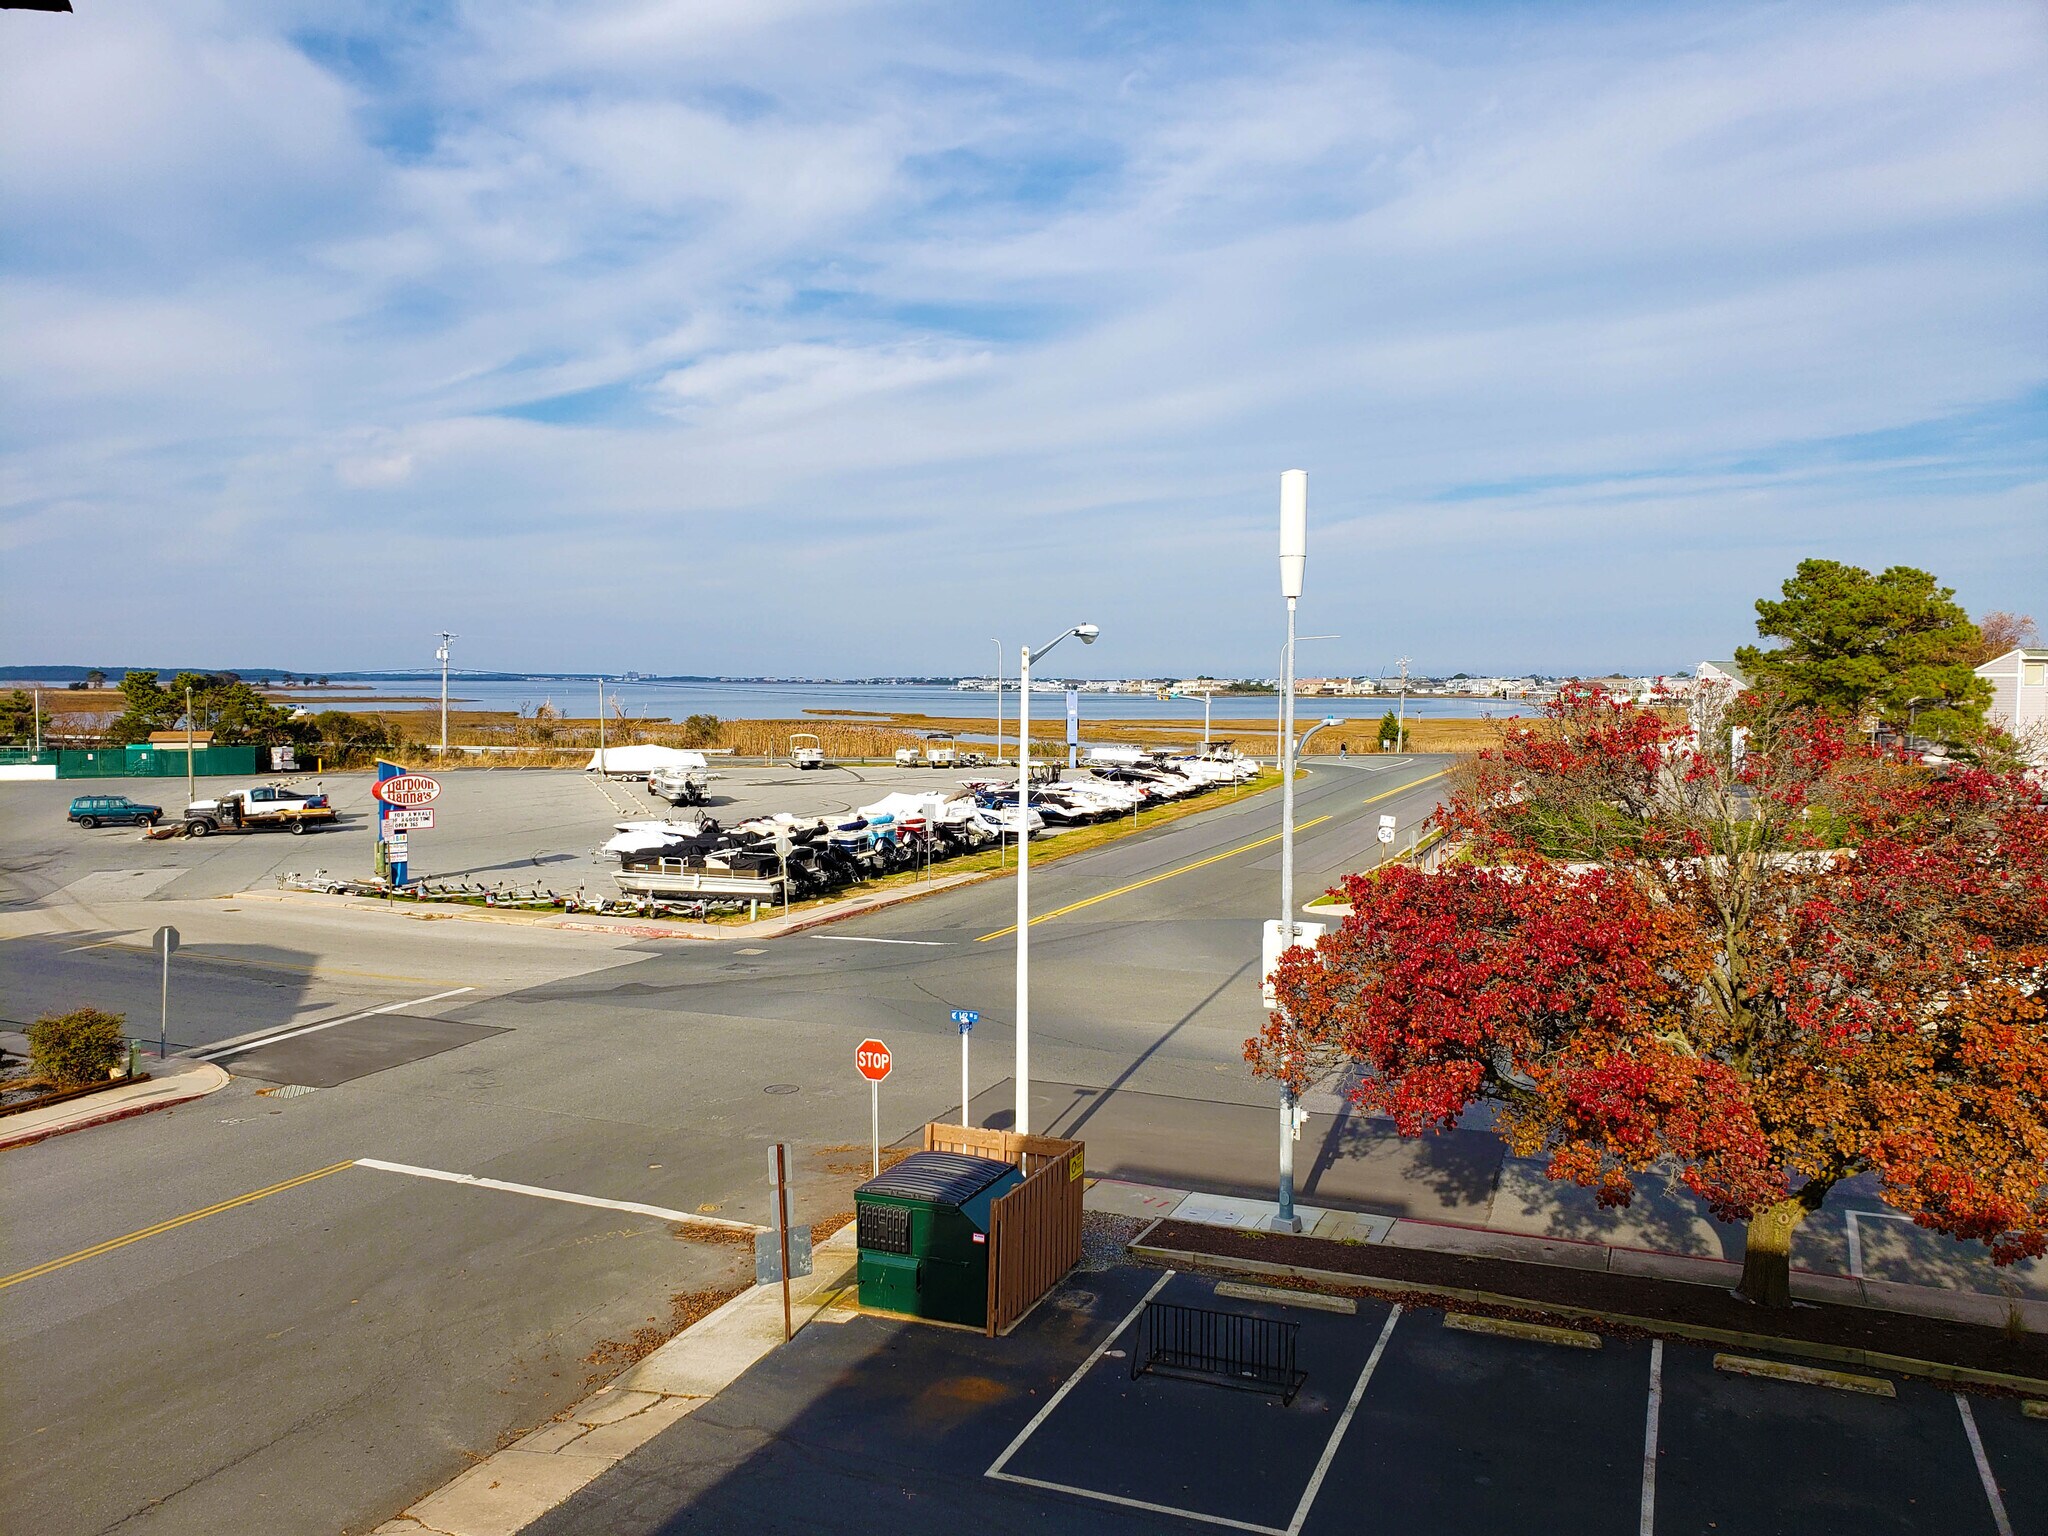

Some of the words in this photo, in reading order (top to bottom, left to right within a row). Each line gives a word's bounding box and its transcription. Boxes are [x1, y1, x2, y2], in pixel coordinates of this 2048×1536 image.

[387, 778, 434, 793] Harpoon
[387, 789, 432, 803] Hanna's
[1380, 830, 1392, 839] 54
[858, 1051, 890, 1070] STOP
